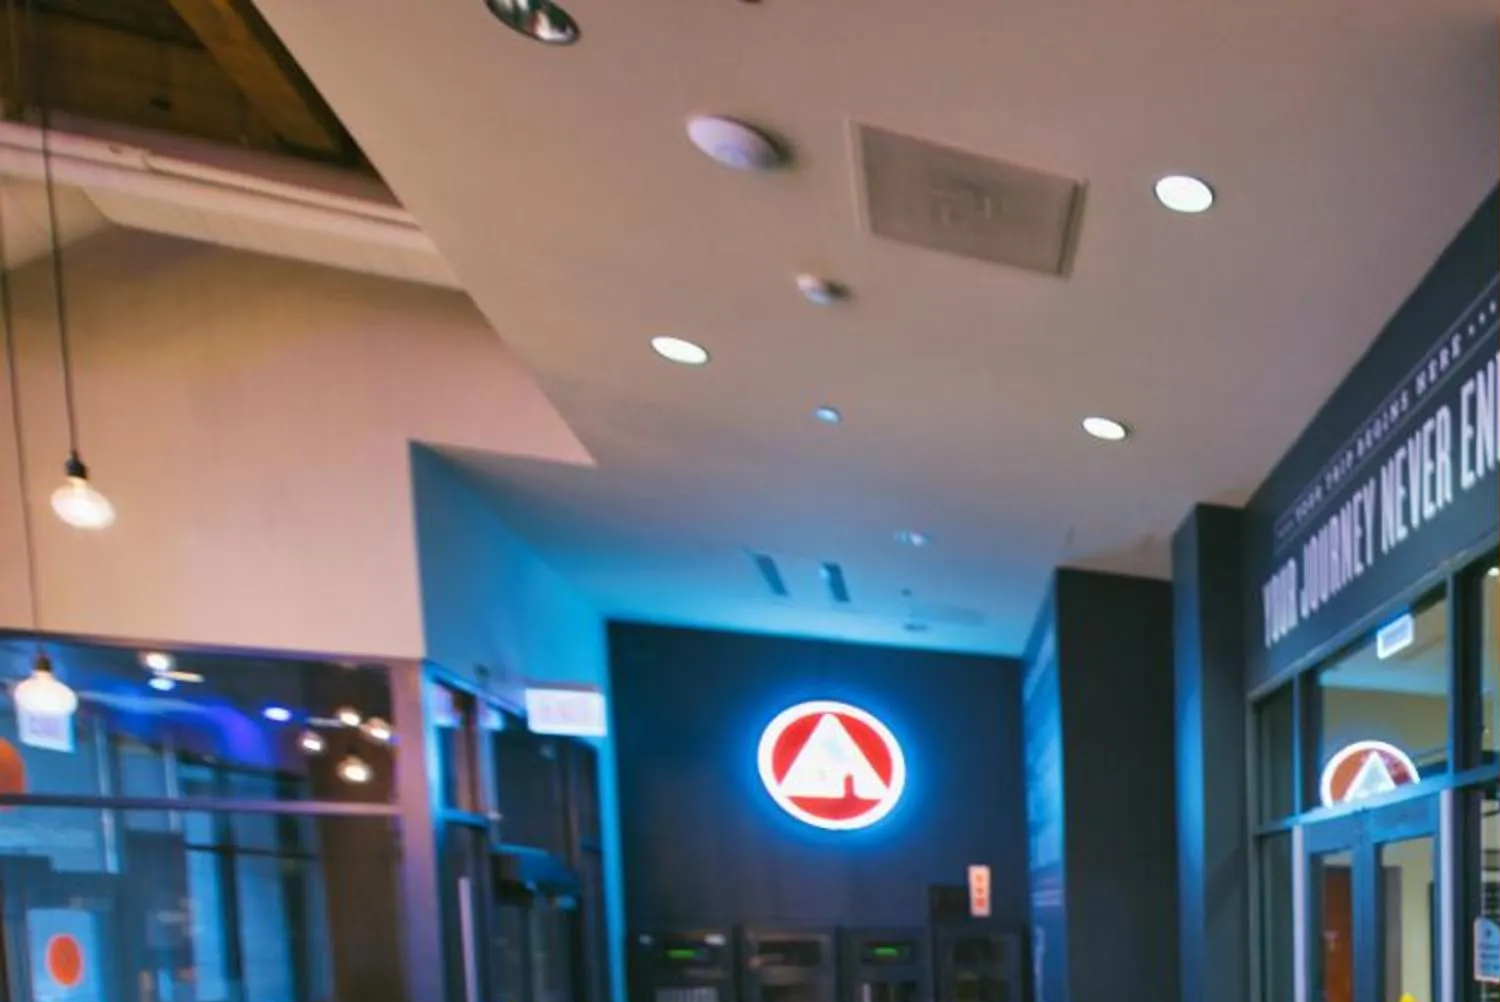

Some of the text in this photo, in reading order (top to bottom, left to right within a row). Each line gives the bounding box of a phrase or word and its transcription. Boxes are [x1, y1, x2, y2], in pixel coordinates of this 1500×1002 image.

[1356, 390, 1408, 457] BEGINS
[1415, 332, 1461, 395] HERE
[1263, 558, 1298, 647] YOUR
[1301, 478, 1376, 619] JOURNEY
[1381, 404, 1453, 555] NEVER
